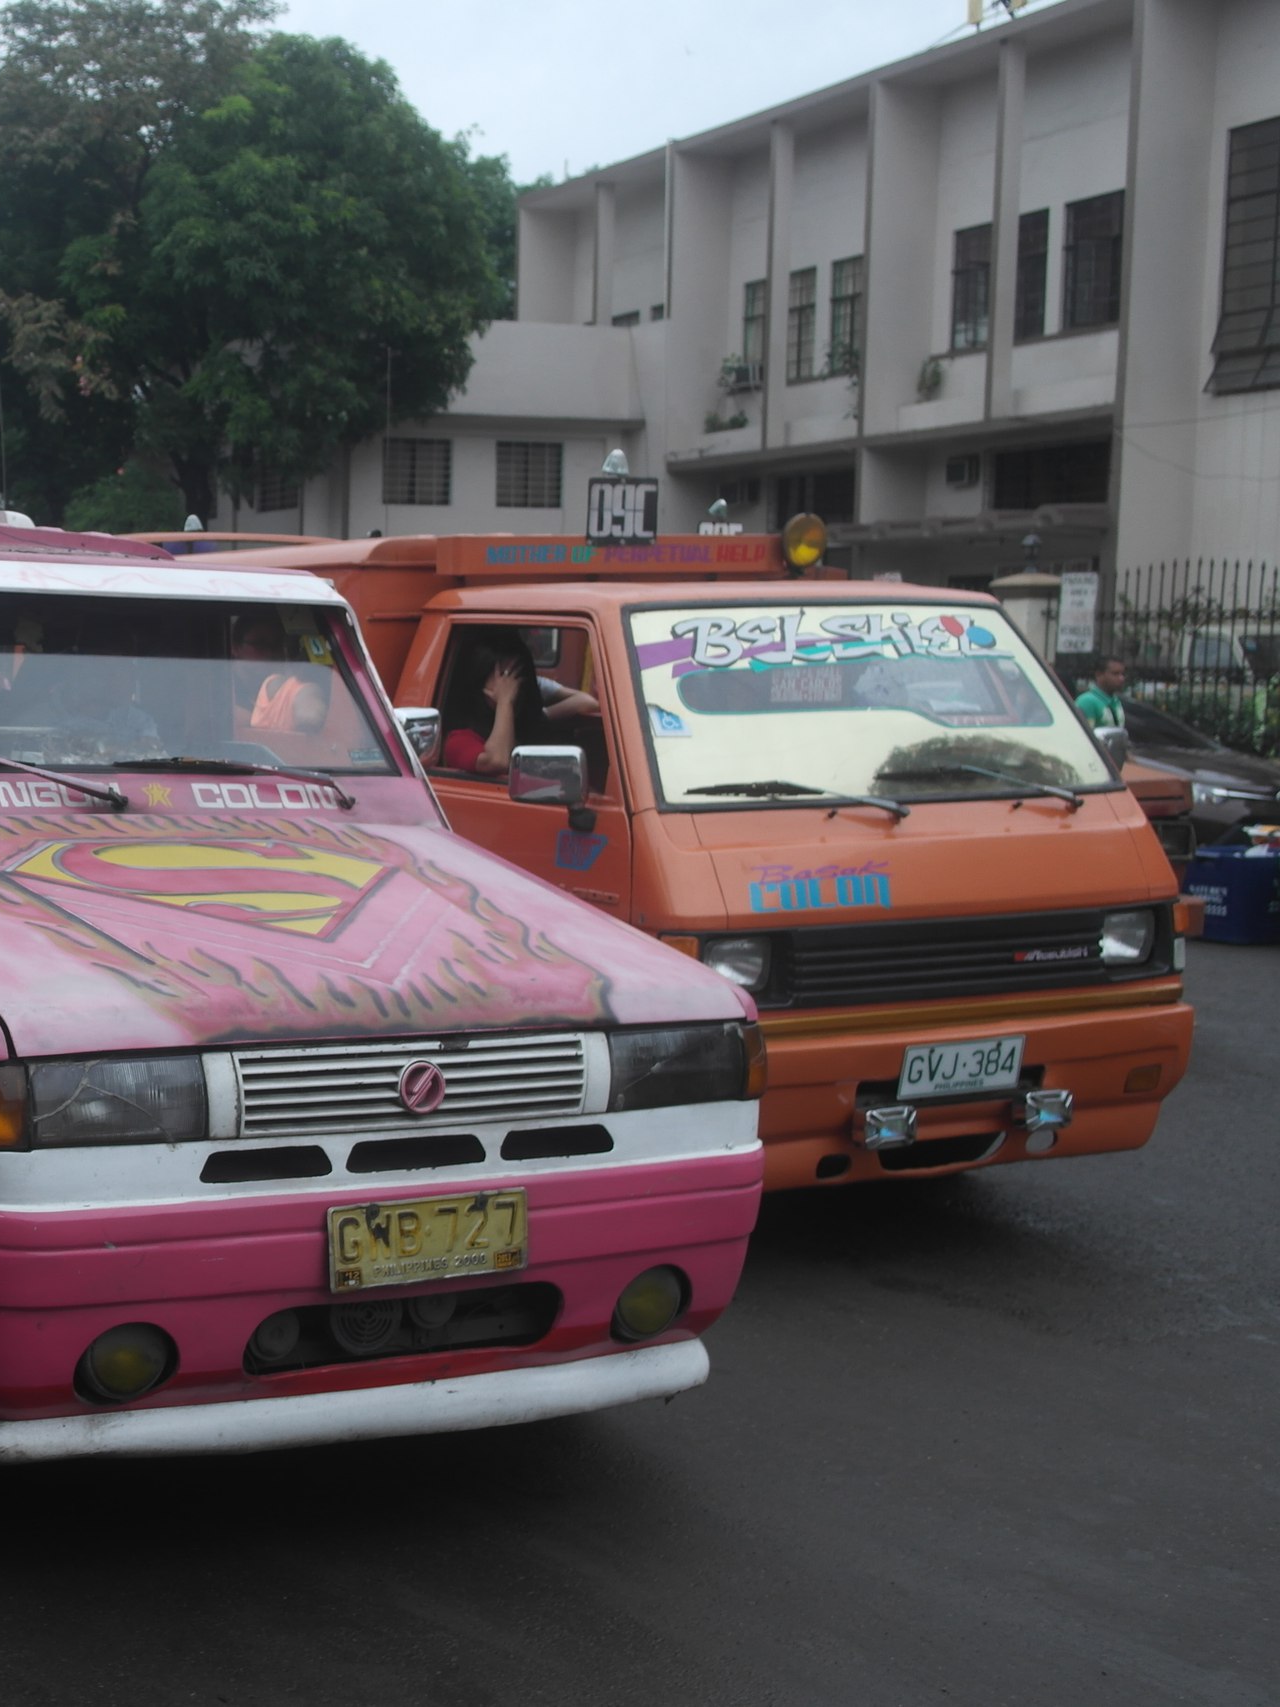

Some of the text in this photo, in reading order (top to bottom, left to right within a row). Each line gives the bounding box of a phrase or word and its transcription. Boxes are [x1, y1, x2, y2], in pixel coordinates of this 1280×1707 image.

[588, 482, 657, 538] 09C
[485, 544, 766, 564] MOTHER OF PERPETUAL HELP
[192, 783, 341, 810] COLON
